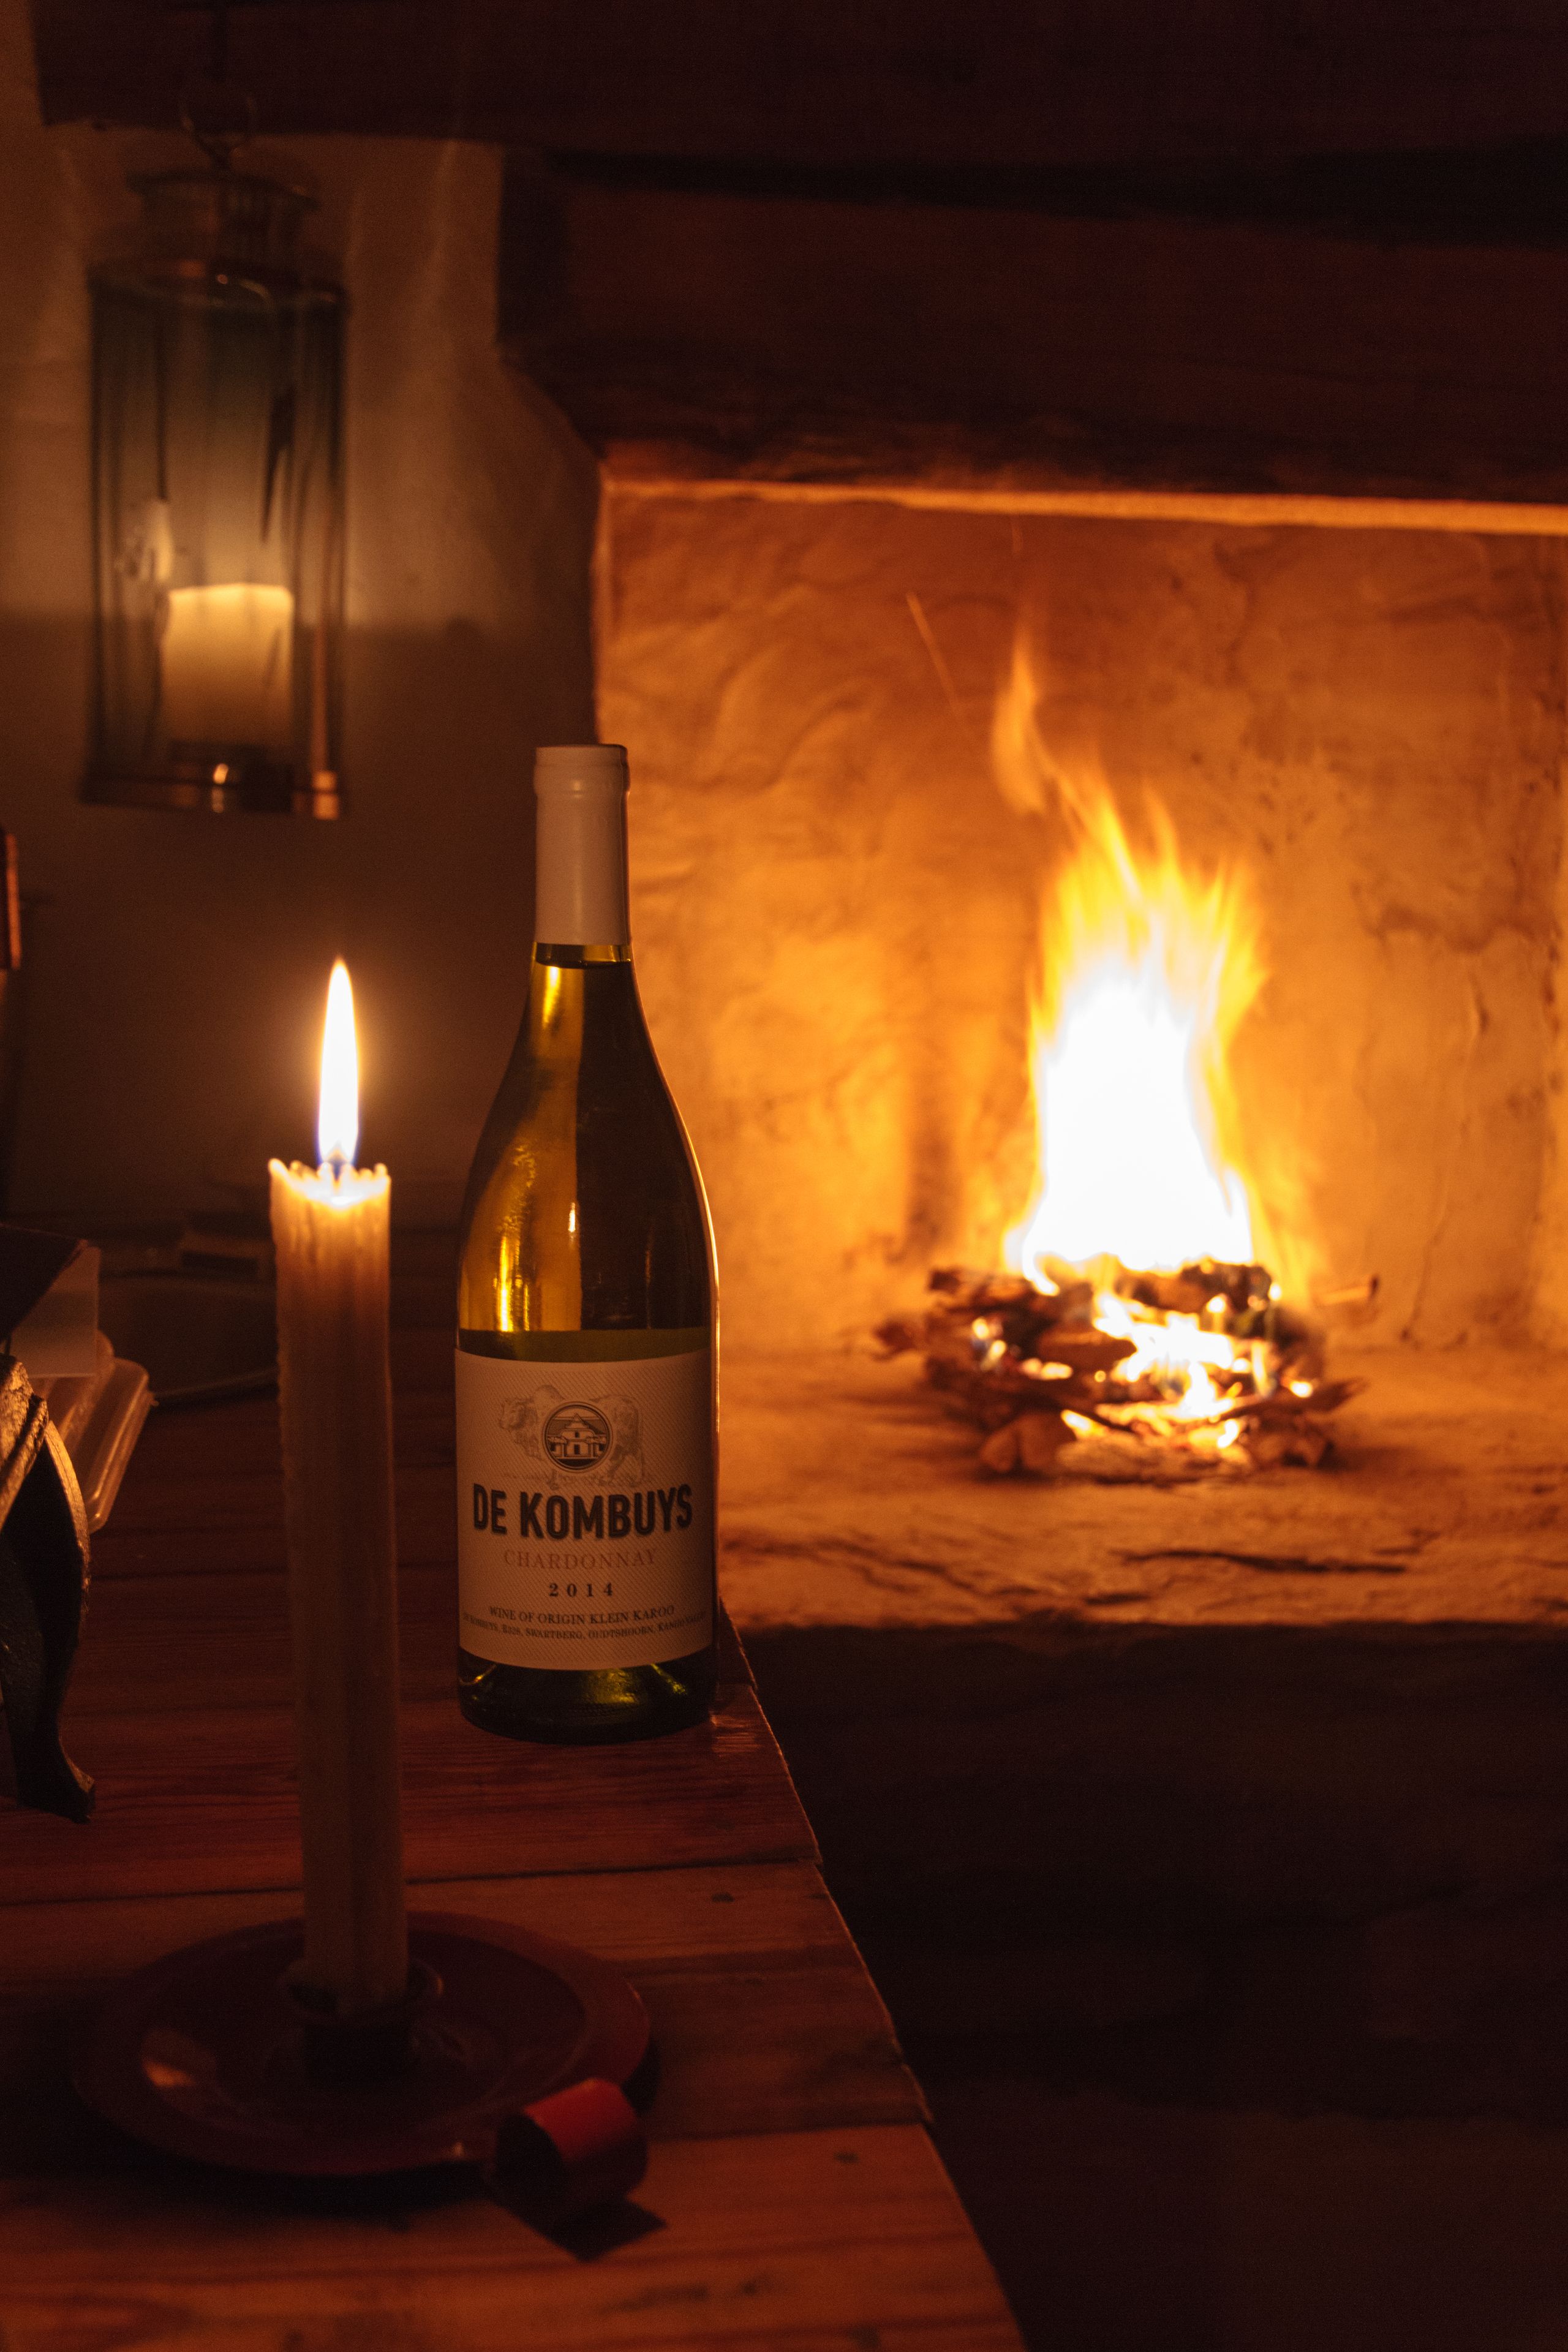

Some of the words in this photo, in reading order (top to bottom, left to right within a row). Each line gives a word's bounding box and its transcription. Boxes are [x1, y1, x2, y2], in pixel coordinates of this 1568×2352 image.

[473, 1483, 507, 1535] DE
[520, 1483, 693, 1540] KOMBUYS
[504, 1548, 657, 1570] CHARDONNAY
[548, 1583, 613, 1597] 2014
[490, 1606, 516, 1621] WINE
[519, 1611, 535, 1623] OF
[538, 1613, 585, 1624] ORIGIN
[590, 1611, 628, 1624] KLEIN
[633, 1604, 674, 1621] KAROO
